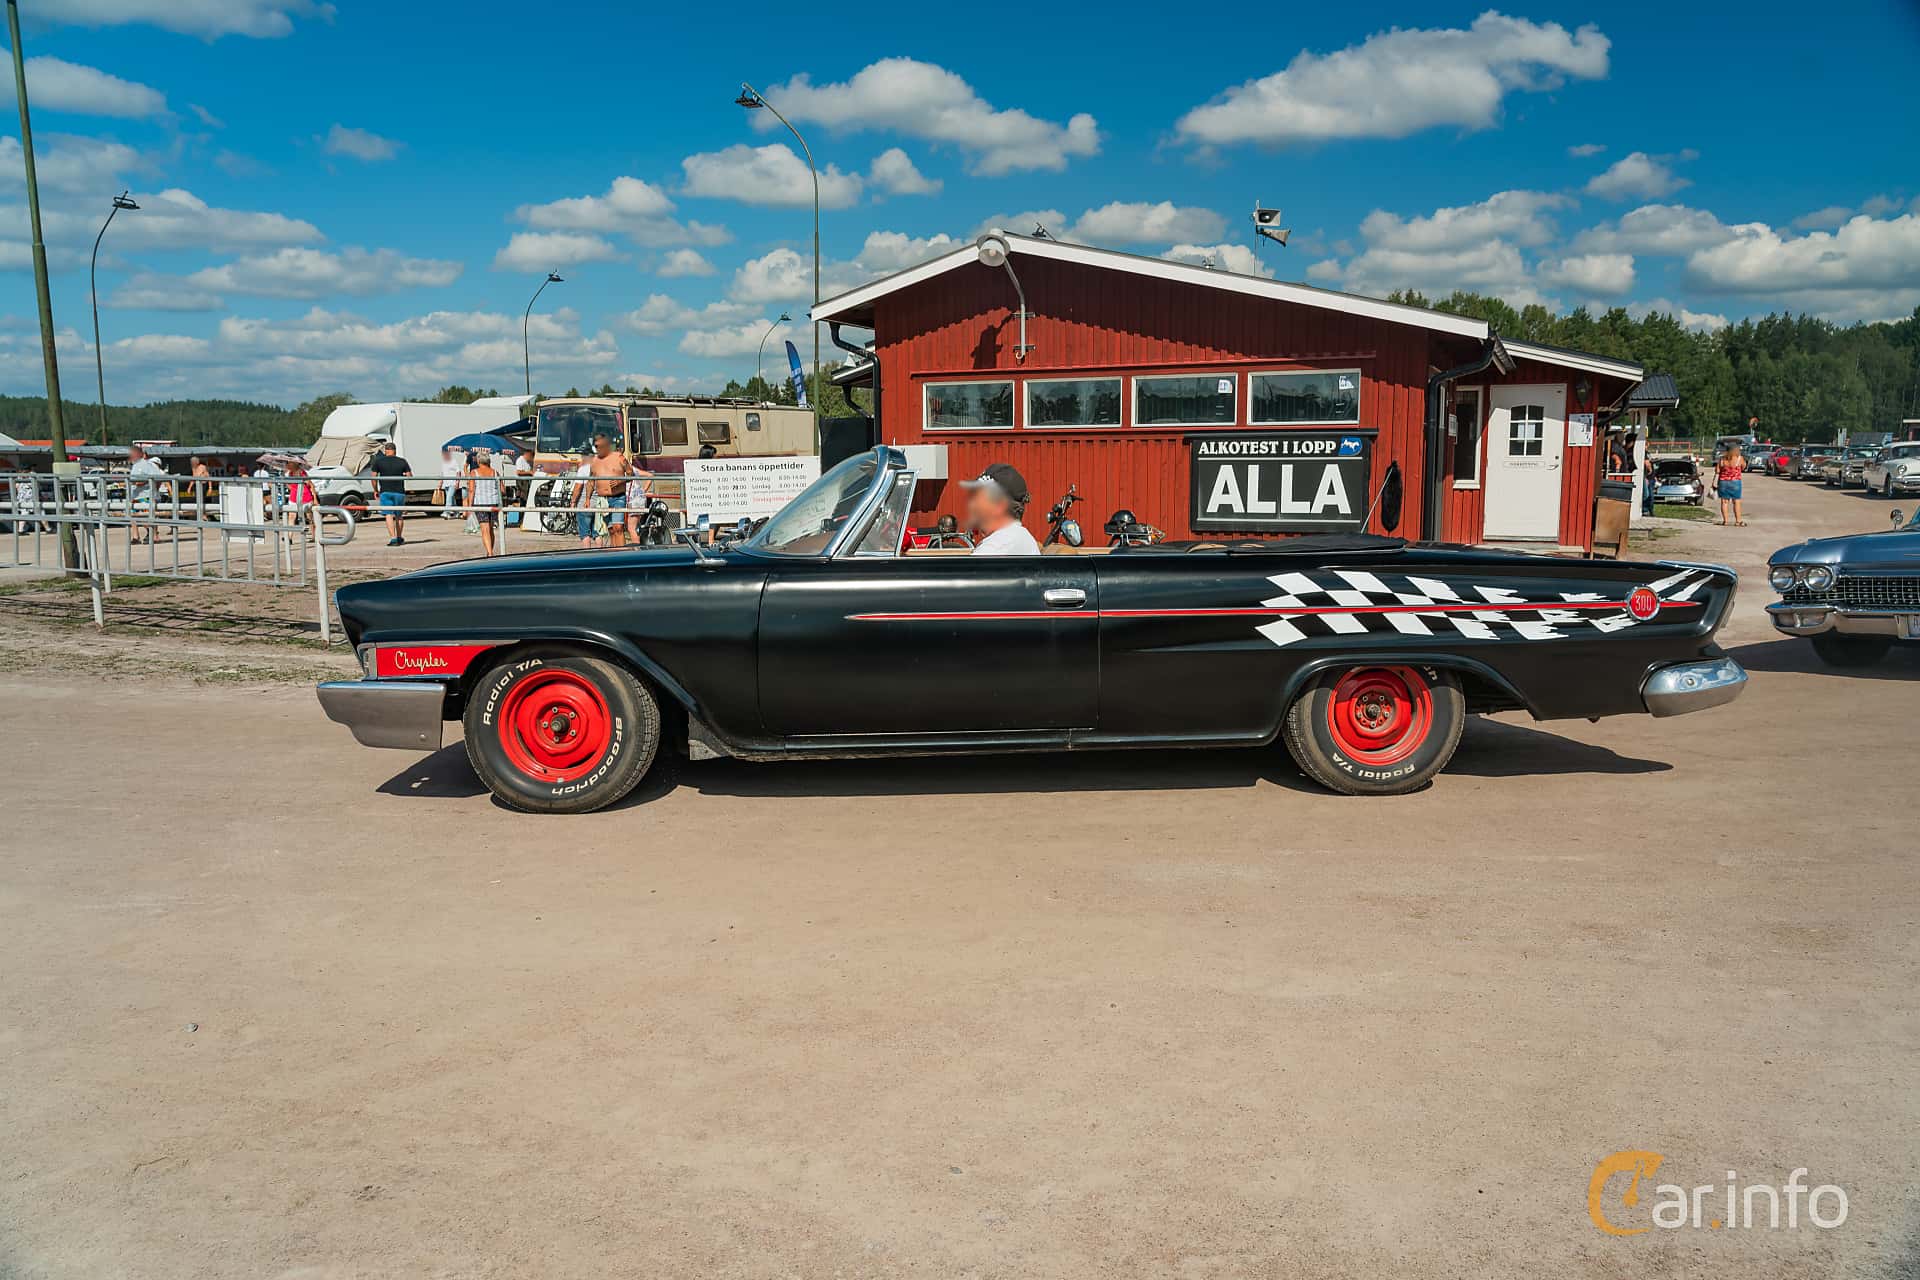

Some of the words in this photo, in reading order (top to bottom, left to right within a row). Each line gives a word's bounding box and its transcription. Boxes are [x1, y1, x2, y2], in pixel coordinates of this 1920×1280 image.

[1198, 441, 1279, 455] ALKOTEST
[1282, 441, 1289, 454] I
[1293, 441, 1337, 454] LOPP
[701, 464, 724, 472] Stora
[726, 463, 757, 472] banans
[759, 461, 804, 472] öppettider
[1206, 464, 1352, 514] ALLA
[1635, 594, 1652, 612] 300
[395, 650, 449, 673] Chrysler
[483, 671, 514, 726] Radial
[516, 658, 543, 672] T/A
[551, 716, 623, 796] BFGoodrich
[1332, 752, 1353, 773] T/A
[1358, 763, 1416, 780] Radial
